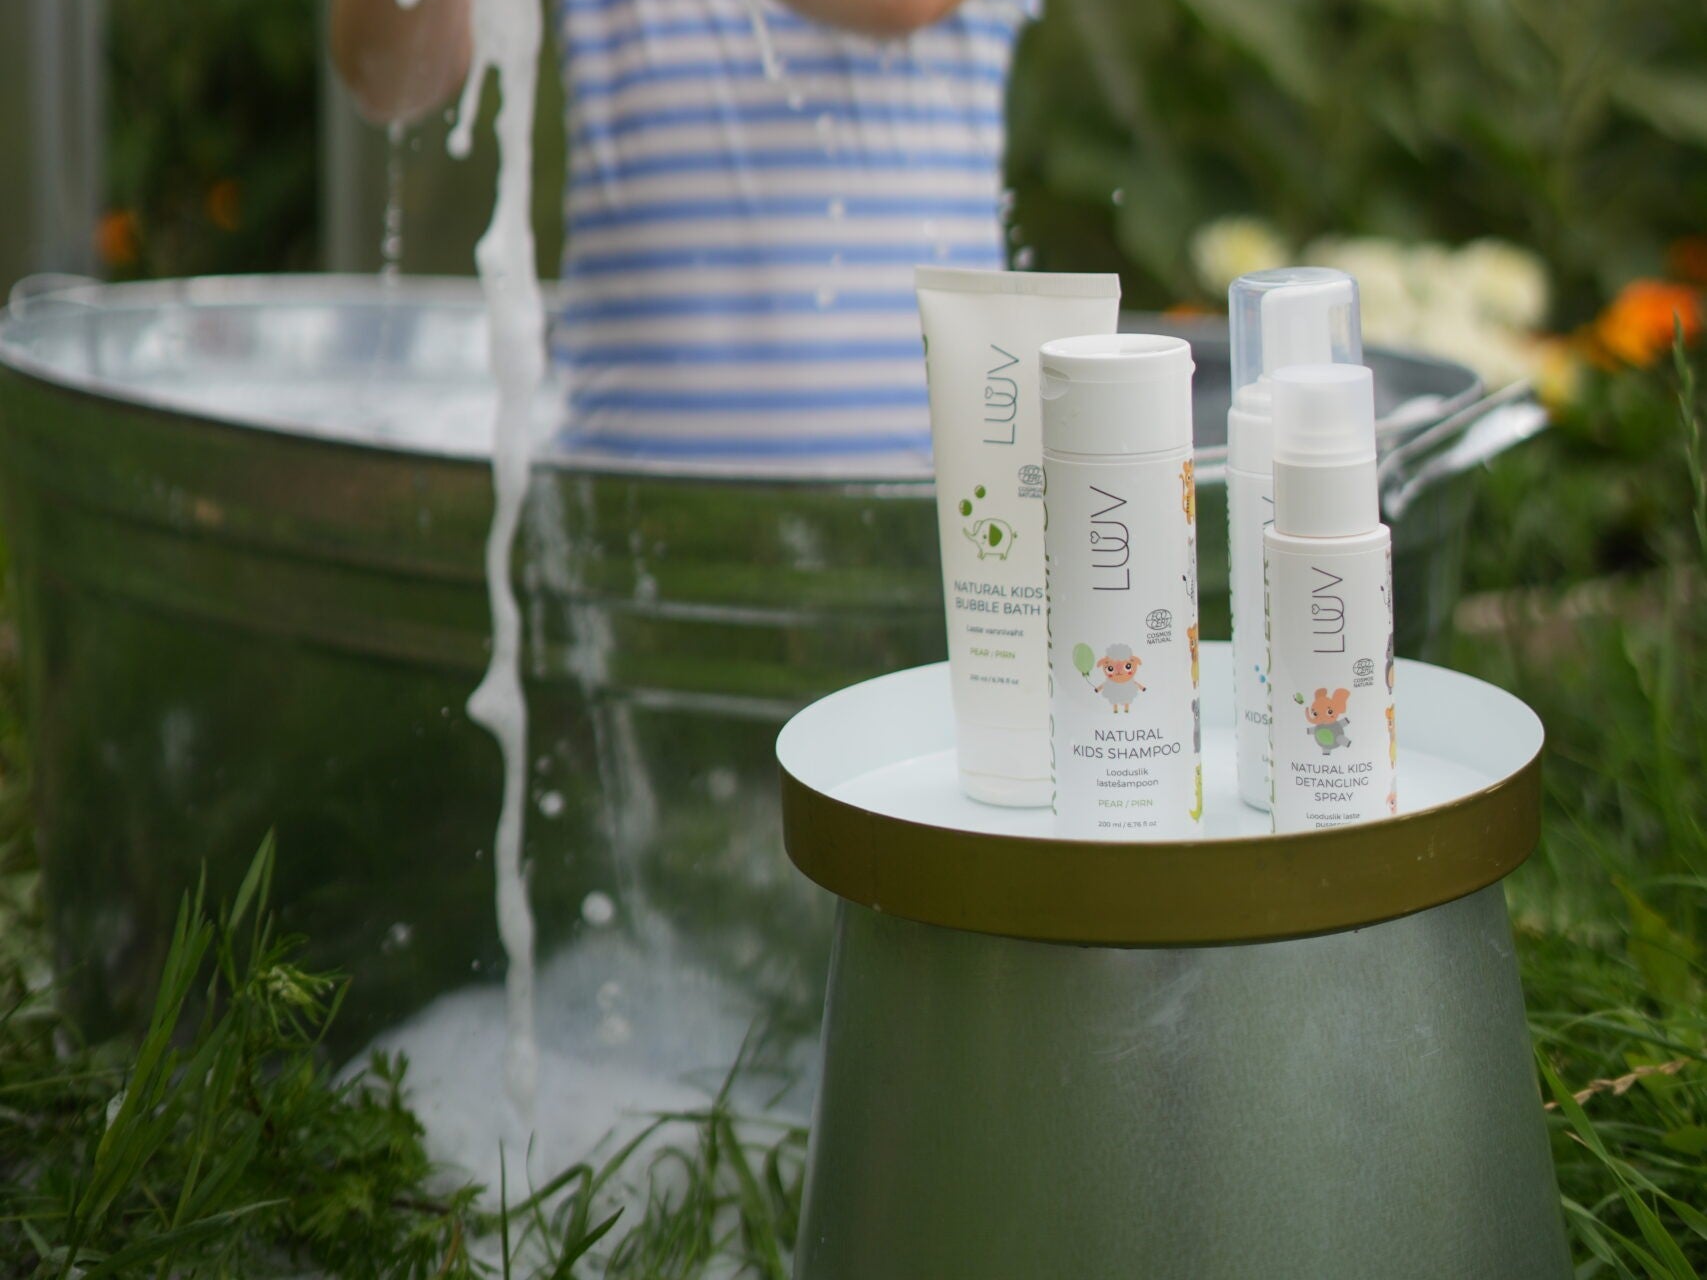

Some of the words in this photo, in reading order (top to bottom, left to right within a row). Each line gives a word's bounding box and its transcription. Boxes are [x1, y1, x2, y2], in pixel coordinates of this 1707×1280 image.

[953, 580, 1007, 597] NATURAL
[1011, 586, 1044, 599] KIDS
[955, 597, 1000, 613] BUBBLE
[1003, 602, 1041, 616] BATH
[1146, 631, 1172, 639] COSMOS
[1146, 637, 1172, 645] NATURAL
[969, 647, 989, 657] PEAR
[1245, 710, 1268, 725] KIDS
[1094, 728, 1164, 742] NATURAL
[1073, 744, 1103, 759] KIDS
[1107, 742, 1181, 760] SHAMPOO
[1106, 767, 1149, 777] Looduslik
[1291, 761, 1344, 775] NATURAL
[1347, 761, 1373, 773] KIDS
[1295, 776, 1369, 788] DETANGLING
[1314, 792, 1354, 802] SPRAY
[1098, 799, 1123, 808] PEAR
[1131, 799, 1153, 808] PIRN
[1306, 812, 1341, 820] Looduslik
[1343, 812, 1360, 820] laste
